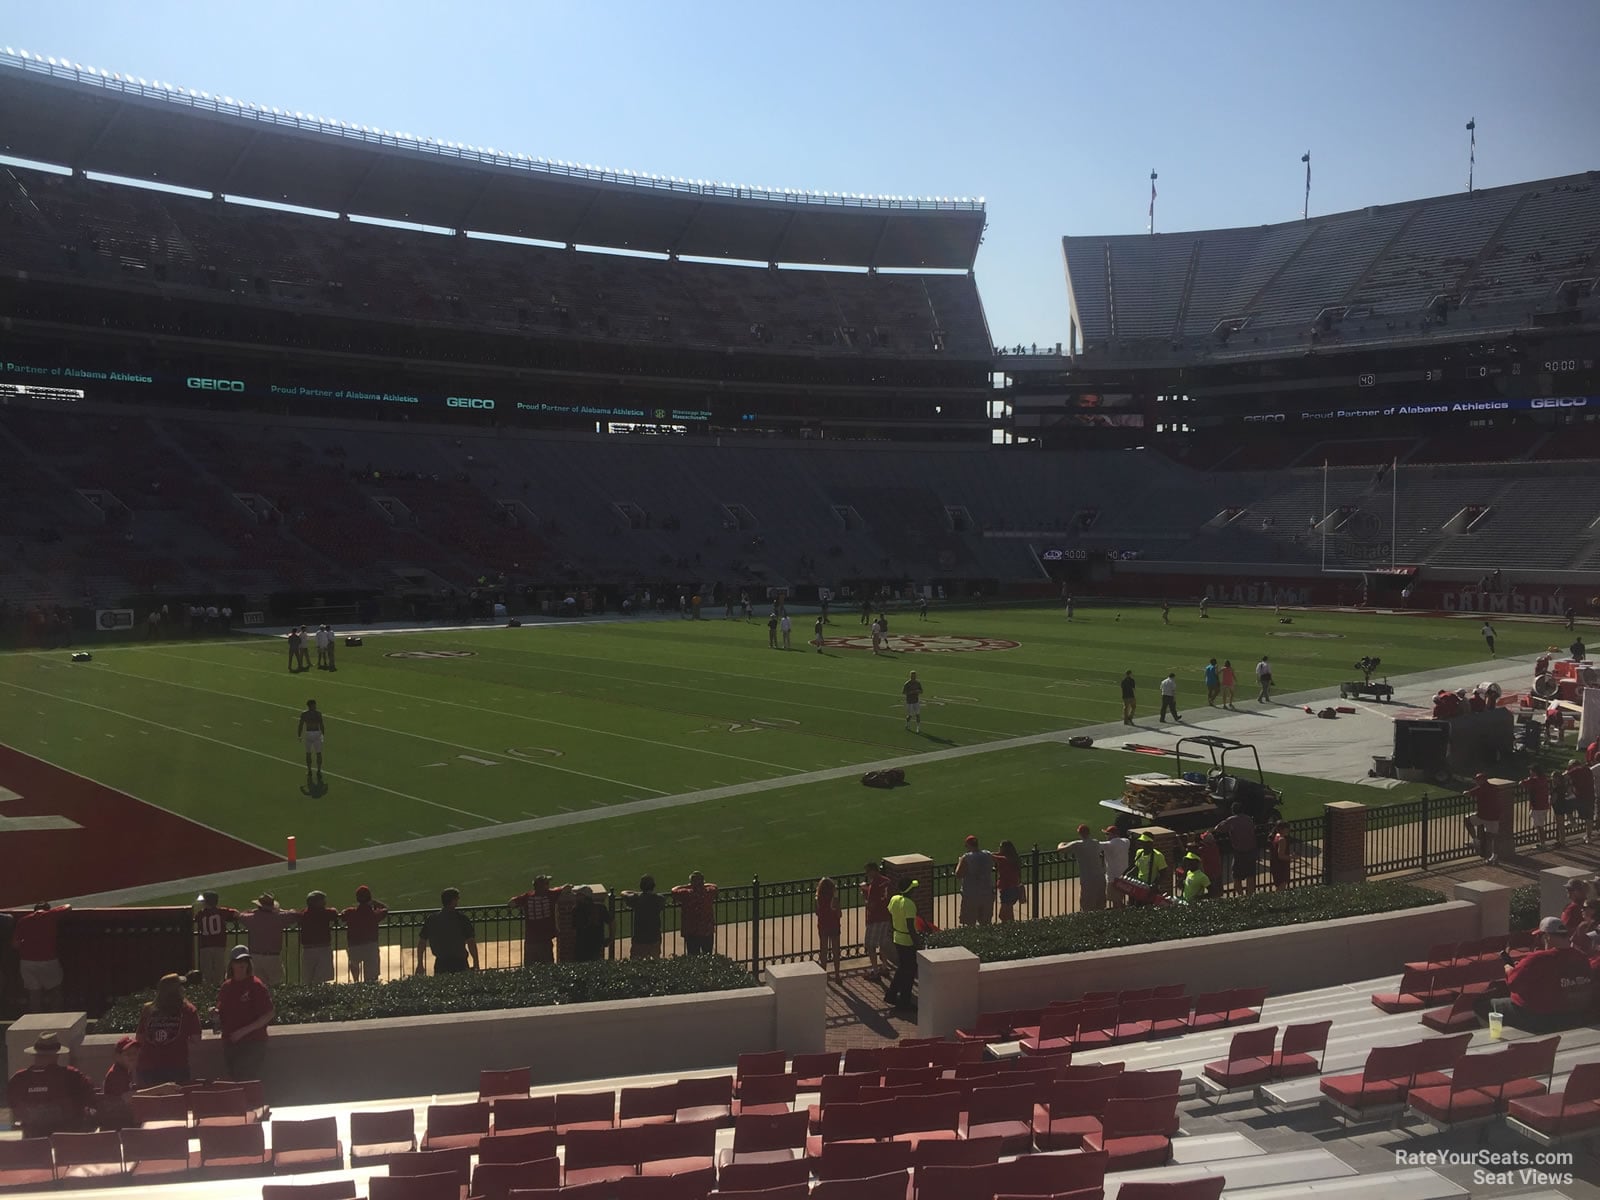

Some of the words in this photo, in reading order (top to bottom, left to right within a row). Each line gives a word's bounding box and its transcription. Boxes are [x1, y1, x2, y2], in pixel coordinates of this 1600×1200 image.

[7, 362, 48, 374] Partner
[64, 368, 107, 379] Alabama
[109, 371, 153, 383] Athletics
[186, 377, 246, 392] GEICO
[271, 385, 297, 395] Proud
[299, 387, 333, 397] Partner
[335, 390, 345, 398] of
[346, 391, 381, 401] Alabama
[382, 393, 420, 404] Athletics
[446, 396, 495, 410] GEICO
[1530, 396, 1587, 409] GEICO
[517, 402, 540, 411] Proud
[541, 404, 570, 412] Partner
[580, 406, 611, 415] Alabama
[613, 407, 644, 417] Athletics
[1301, 411, 1334, 421] Proud
[1337, 409, 1380, 418] Partner
[1383, 407, 1396, 416] of
[1399, 404, 1449, 414] Alabama
[1452, 401, 1509, 412] Athletics
[1442, 590, 1567, 615] CRIMSON
[202, 914, 221, 936] 10
